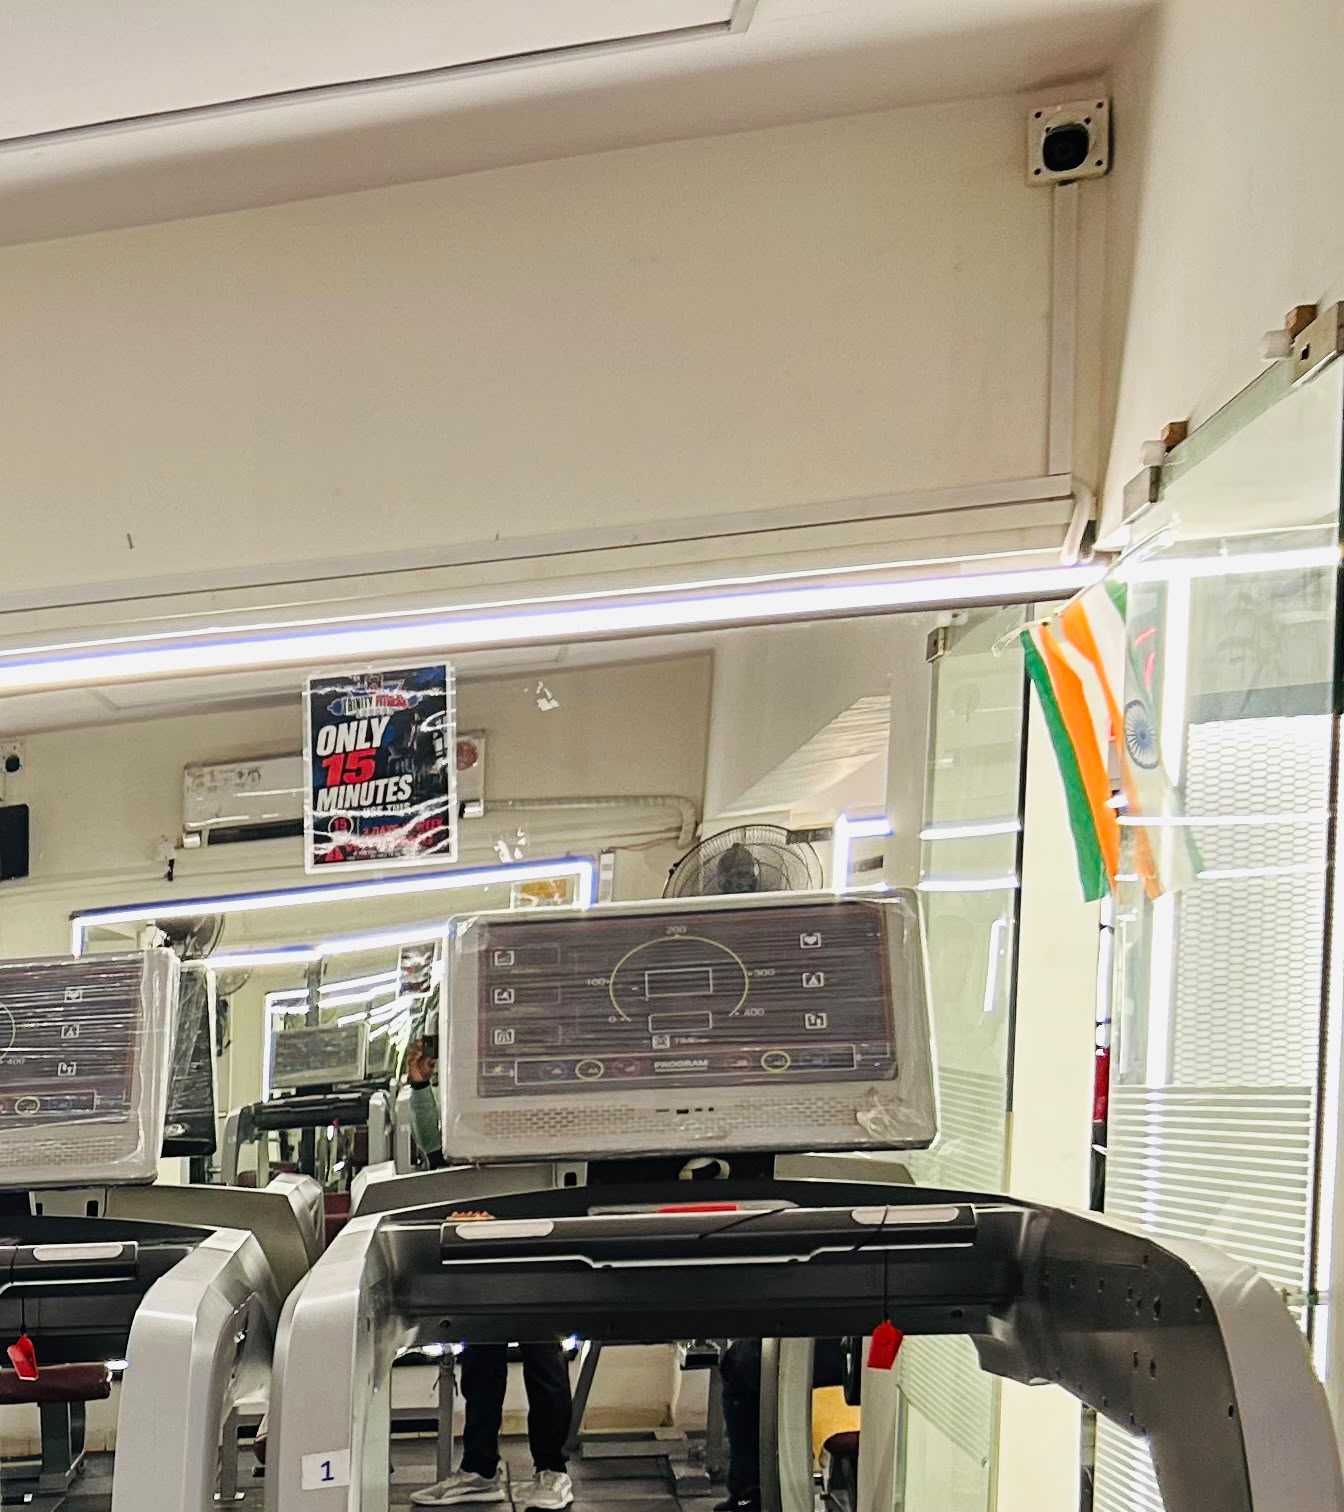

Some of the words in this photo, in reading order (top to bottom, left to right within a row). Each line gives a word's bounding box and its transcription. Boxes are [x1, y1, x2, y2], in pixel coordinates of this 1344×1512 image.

[316, 716, 391, 756] ONLY
[322, 748, 377, 788] 15
[316, 774, 413, 812] MINUTES
[654, 1059, 709, 1069] PROGRAM
[321, 1460, 334, 1482] 1
